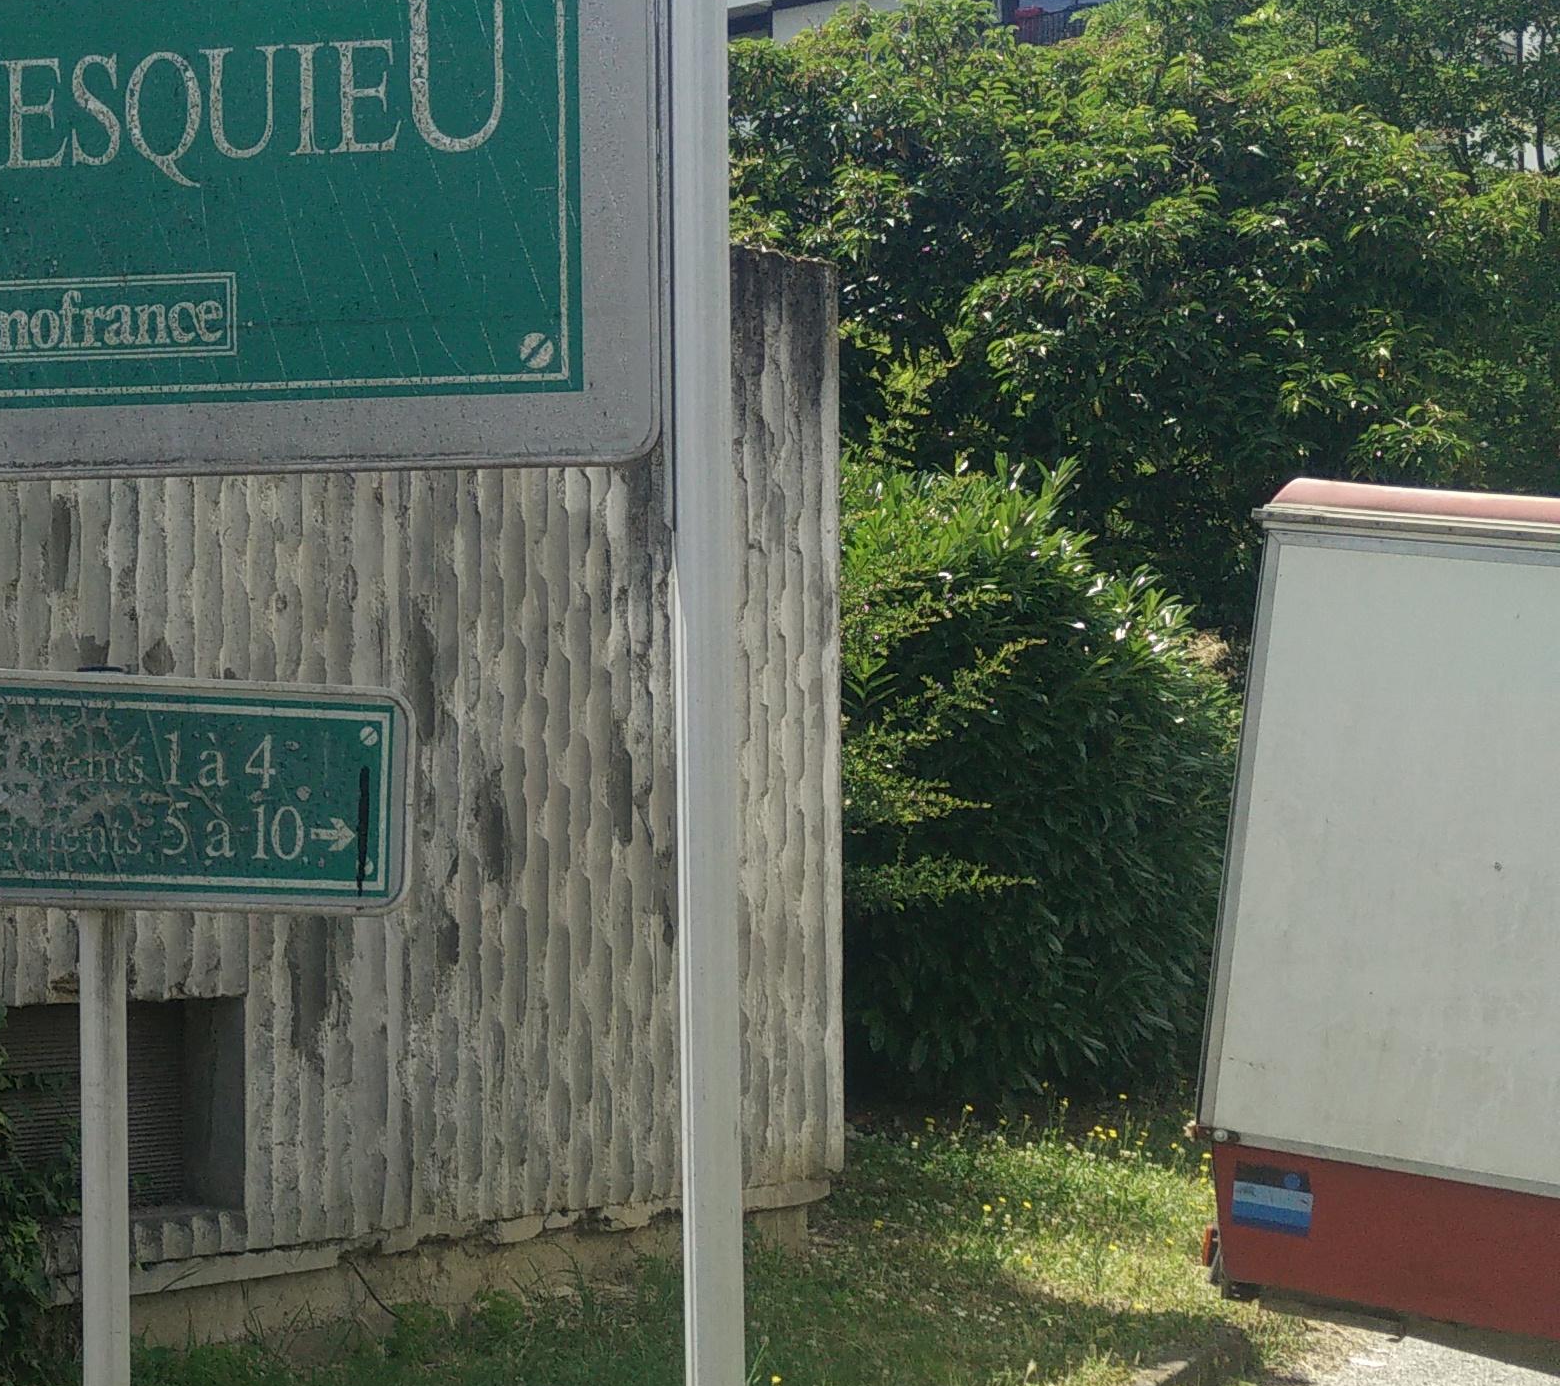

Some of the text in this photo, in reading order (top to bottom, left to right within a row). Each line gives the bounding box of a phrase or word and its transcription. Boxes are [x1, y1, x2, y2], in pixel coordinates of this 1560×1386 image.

[162, 730, 182, 786] 1
[198, 732, 230, 788] à
[244, 733, 277, 790] 4
[162, 801, 191, 856] 5
[250, 803, 306, 861] 10
